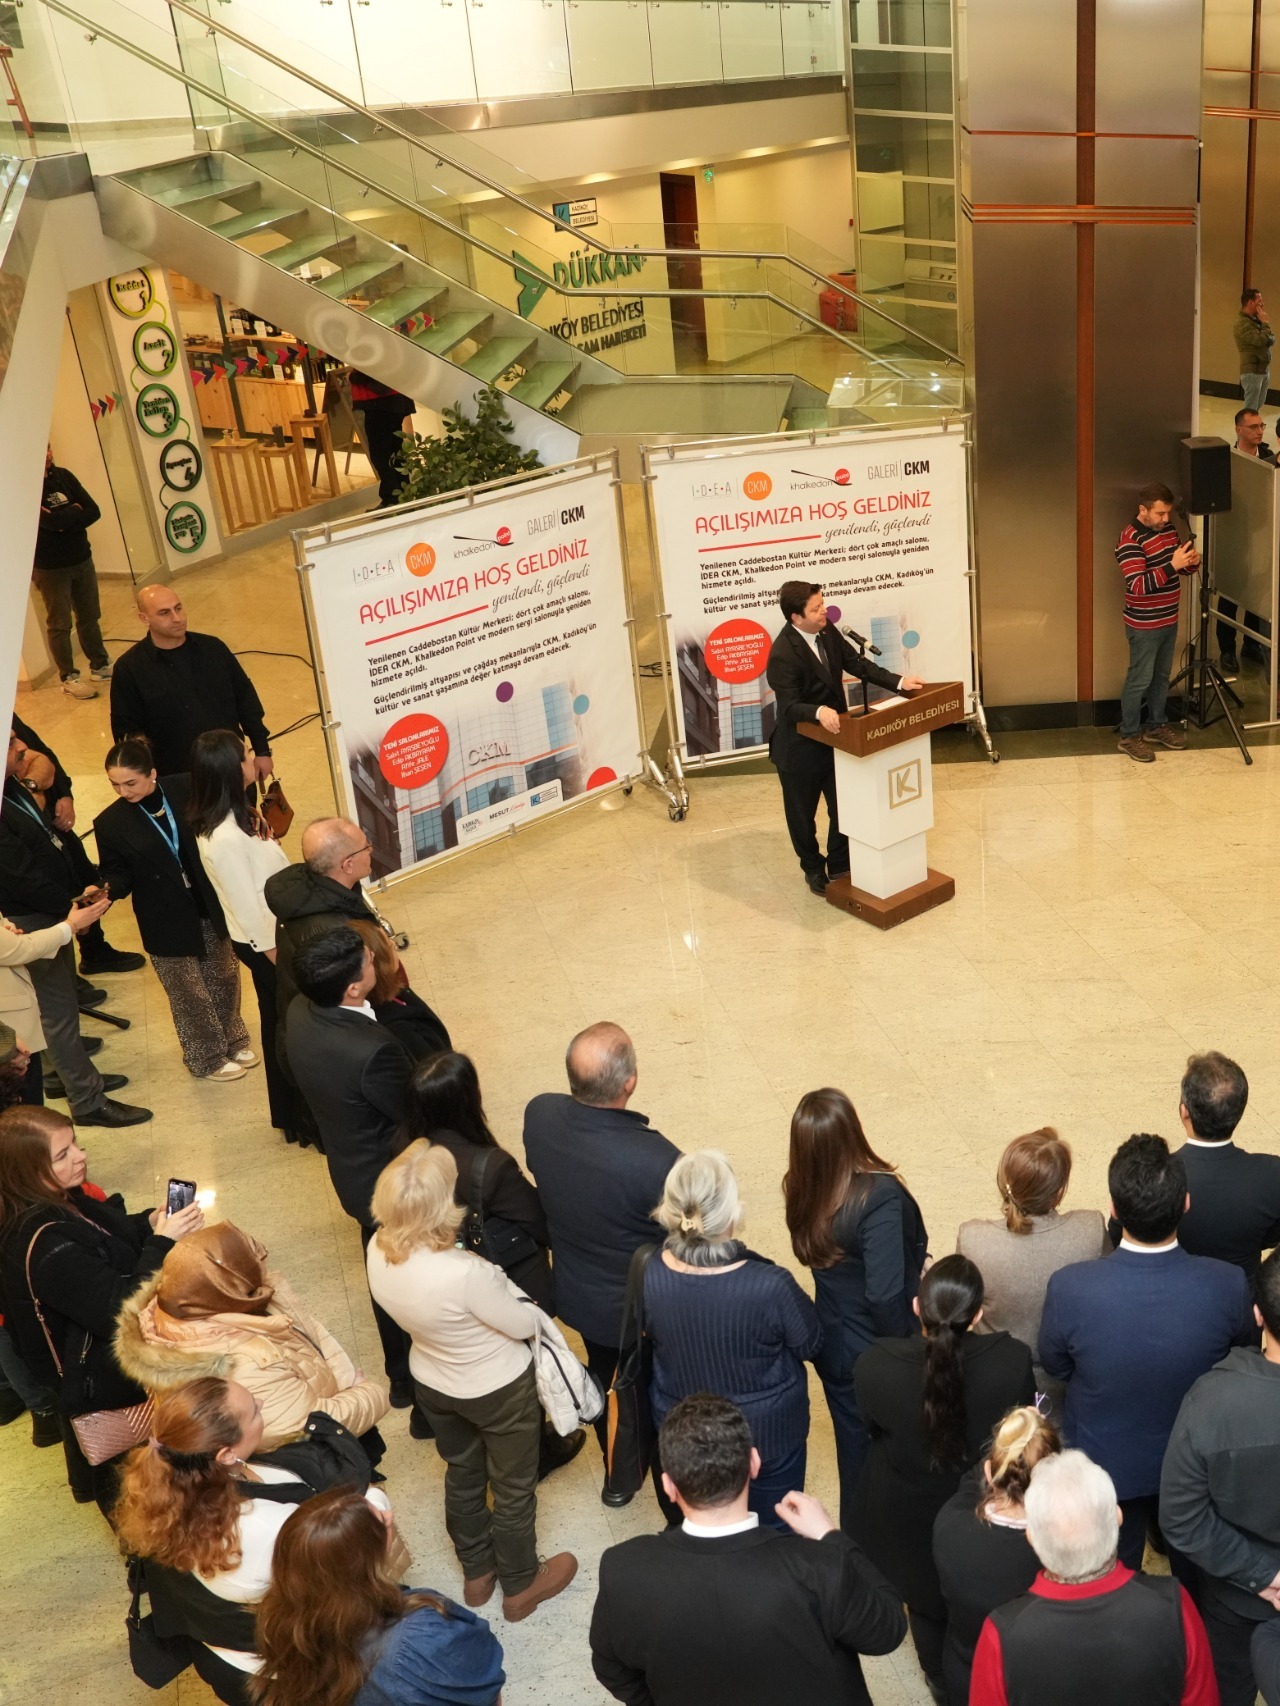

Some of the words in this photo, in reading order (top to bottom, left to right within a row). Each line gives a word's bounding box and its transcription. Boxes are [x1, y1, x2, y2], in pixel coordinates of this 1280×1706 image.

[580, 298, 644, 335] BELEDİYESİ
[790, 480, 833, 491] khalkedon
[867, 461, 898, 480] GALERİ
[904, 460, 930, 476] CKM
[747, 480, 768, 494] CKM
[527, 510, 557, 536] GALERİ
[561, 505, 585, 525] CKM
[695, 506, 803, 536] AÇILIŞIMIZA
[809, 500, 848, 521] HOŞ
[853, 489, 931, 515] GELDİNİZ
[825, 520, 880, 544] yenilendi,
[883, 513, 932, 536] güçlendi
[410, 551, 432, 569] CKM
[453, 541, 496, 559] khalkedon
[700, 561, 737, 570] Yenilenen
[738, 554, 787, 566] Caddebostan
[788, 551, 812, 560] Kültür
[814, 546, 846, 556] Merkezi;
[848, 544, 865, 552] dört
[866, 542, 879, 551] çok
[881, 539, 903, 548] amaçlı
[700, 571, 719, 580] İDEA
[744, 564, 784, 574] Khalkedon
[785, 561, 806, 569] Point
[819, 556, 847, 565] modern
[848, 553, 866, 561] sergi
[867, 548, 900, 559] salonuyla
[902, 545, 929, 555] yeniden
[359, 576, 469, 624] AÇILIŞIMIZA
[474, 562, 511, 590] HOŞ
[516, 538, 589, 576] GELDİNİZ
[492, 579, 544, 614] yenilendi,
[546, 563, 590, 596] güçlendi
[701, 580, 732, 589] hizmete
[734, 576, 756, 586] açıldı.
[703, 592, 756, 605] Güçlendirilmiş
[757, 588, 781, 598] altyap
[828, 576, 873, 588] mekanlarıyla
[703, 606, 727, 614] kültür
[740, 600, 761, 609] sanat
[762, 596, 781, 608] yaşa
[821, 589, 851, 601] katmaya
[853, 585, 876, 593] devam
[878, 581, 904, 590] edecek.
[368, 650, 407, 666] Yenilenen
[408, 634, 457, 654] Caddebostan
[458, 625, 480, 638] Kültür
[482, 615, 514, 630] Merkezi;
[515, 608, 531, 619] dört
[532, 604, 544, 614] çok
[546, 596, 566, 609] amaçlı
[369, 664, 389, 677] İDEA
[415, 645, 454, 663] Khalkedon
[456, 637, 475, 650] Point
[477, 634, 486, 642] ve
[488, 625, 515, 639] modern
[516, 617, 533, 629] sergi
[534, 607, 565, 623] salonuyla
[565, 599, 591, 614] yeniden
[371, 672, 403, 687] hizmete
[405, 664, 427, 677] açıldı.
[373, 682, 428, 705] Güçlendirilmiş
[429, 671, 461, 686] altyapısı
[462, 667, 472, 675] ve
[473, 658, 498, 673] çağdaş
[499, 642, 541, 662] mekanlarıyla
[375, 702, 399, 715] kültür
[401, 698, 411, 706] ve
[413, 690, 434, 703] sanat
[435, 678, 469, 697] yaşamına
[470, 671, 491, 683] değer
[493, 660, 521, 675] katmaya
[523, 652, 545, 664] devam
[546, 642, 571, 656] edecek.
[866, 717, 907, 741] KADIKÖY
